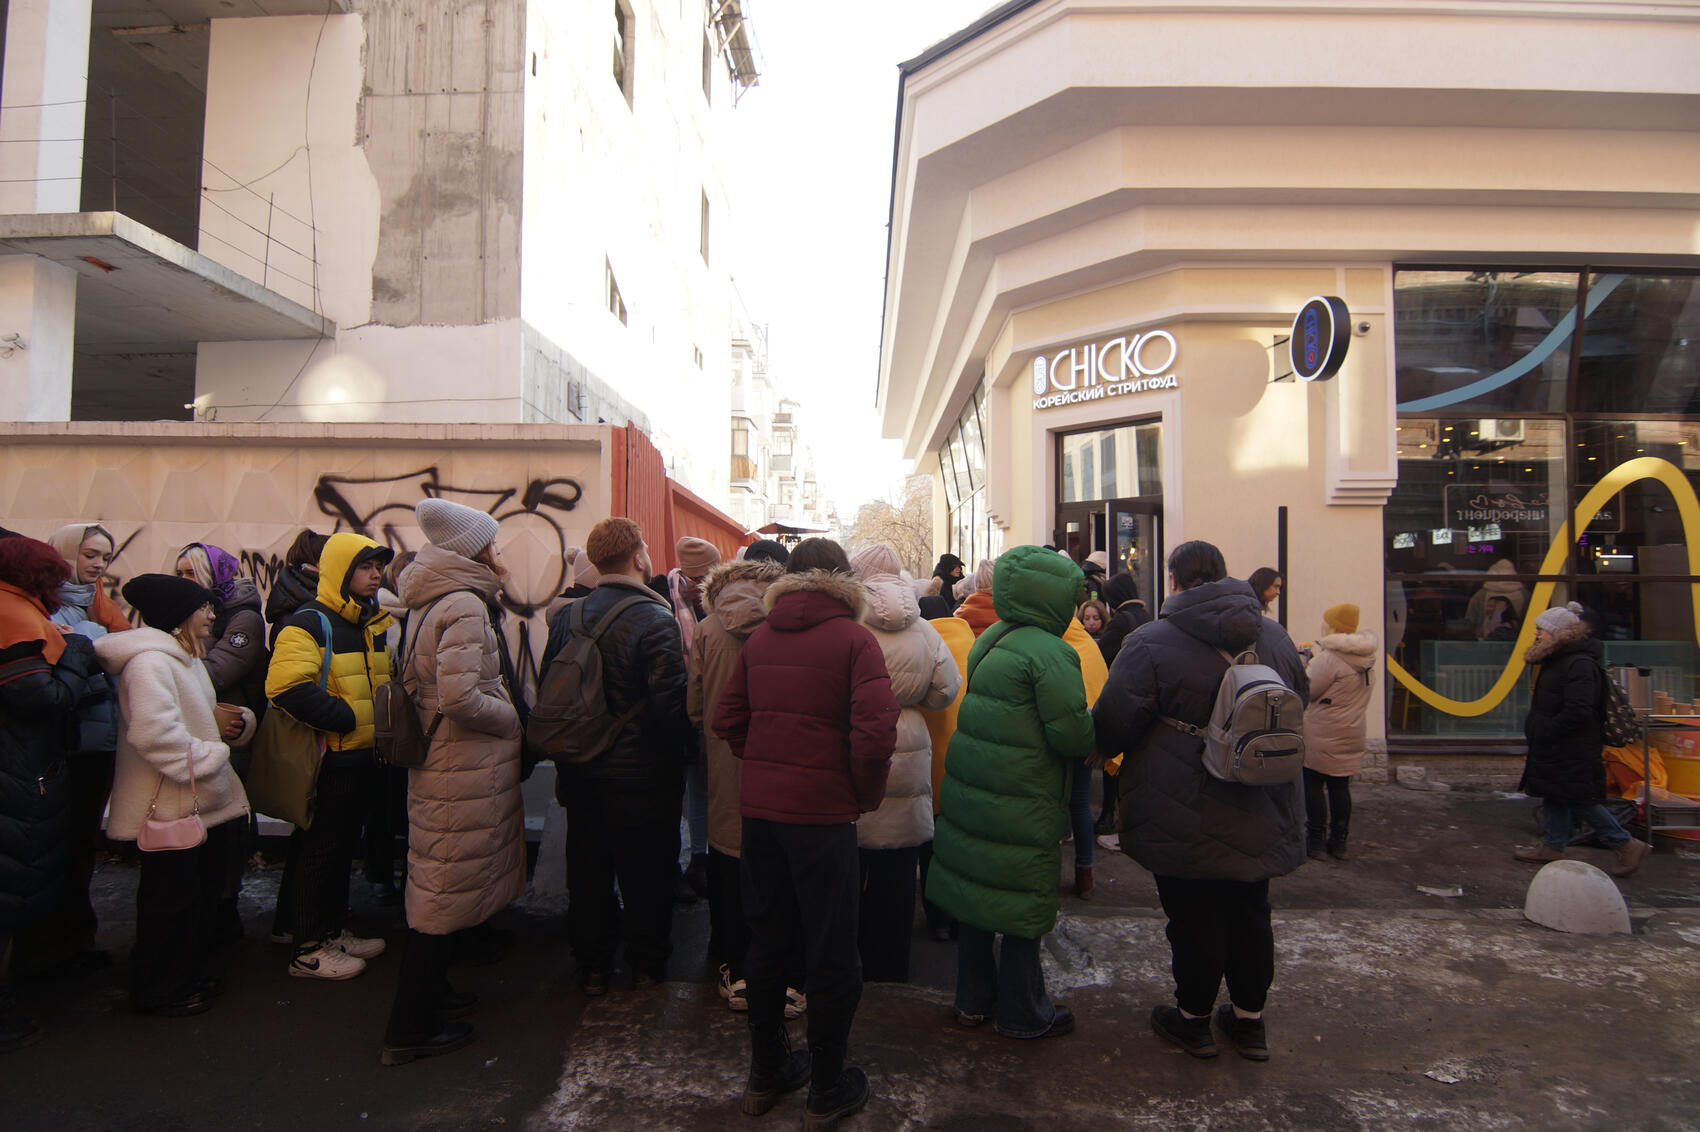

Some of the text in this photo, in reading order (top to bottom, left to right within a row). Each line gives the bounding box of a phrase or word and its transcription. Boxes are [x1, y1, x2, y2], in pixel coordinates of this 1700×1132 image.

[1050, 330, 1177, 390] CHICKO
[1033, 374, 1178, 409] КОРЕЙСКИЙ СТРИТФУД
